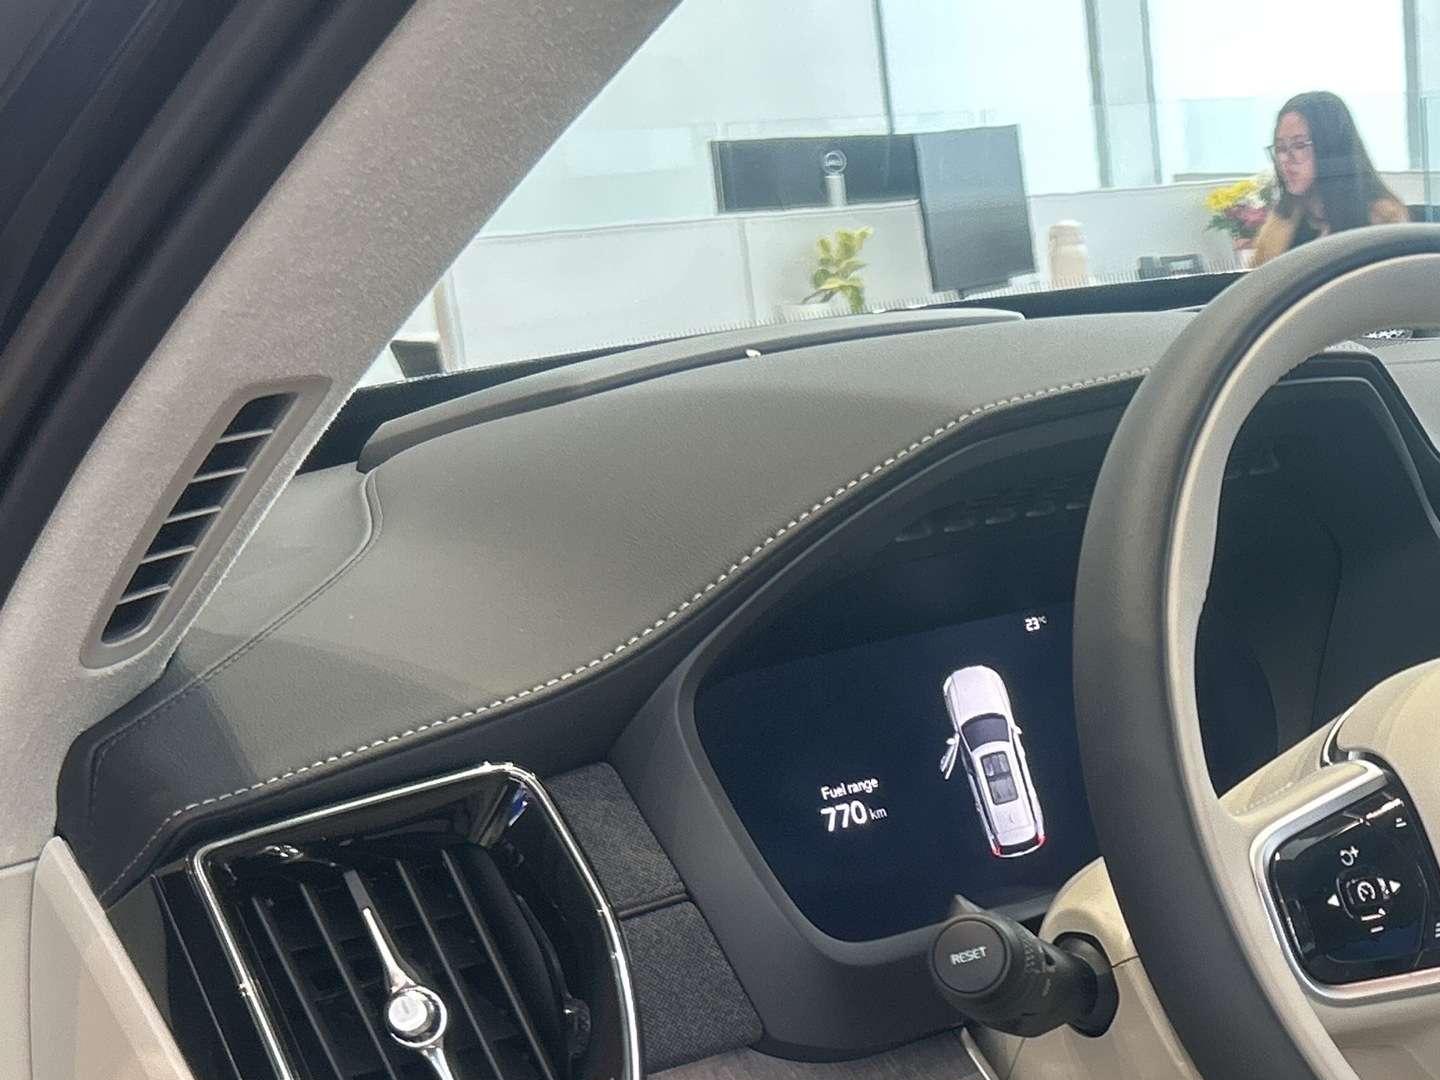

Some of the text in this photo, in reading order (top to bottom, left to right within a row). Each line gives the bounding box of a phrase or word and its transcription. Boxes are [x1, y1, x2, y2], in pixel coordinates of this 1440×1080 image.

[820, 778, 879, 800] Fuel range
[820, 800, 888, 832] 770 km
[950, 946, 987, 965] RESET
